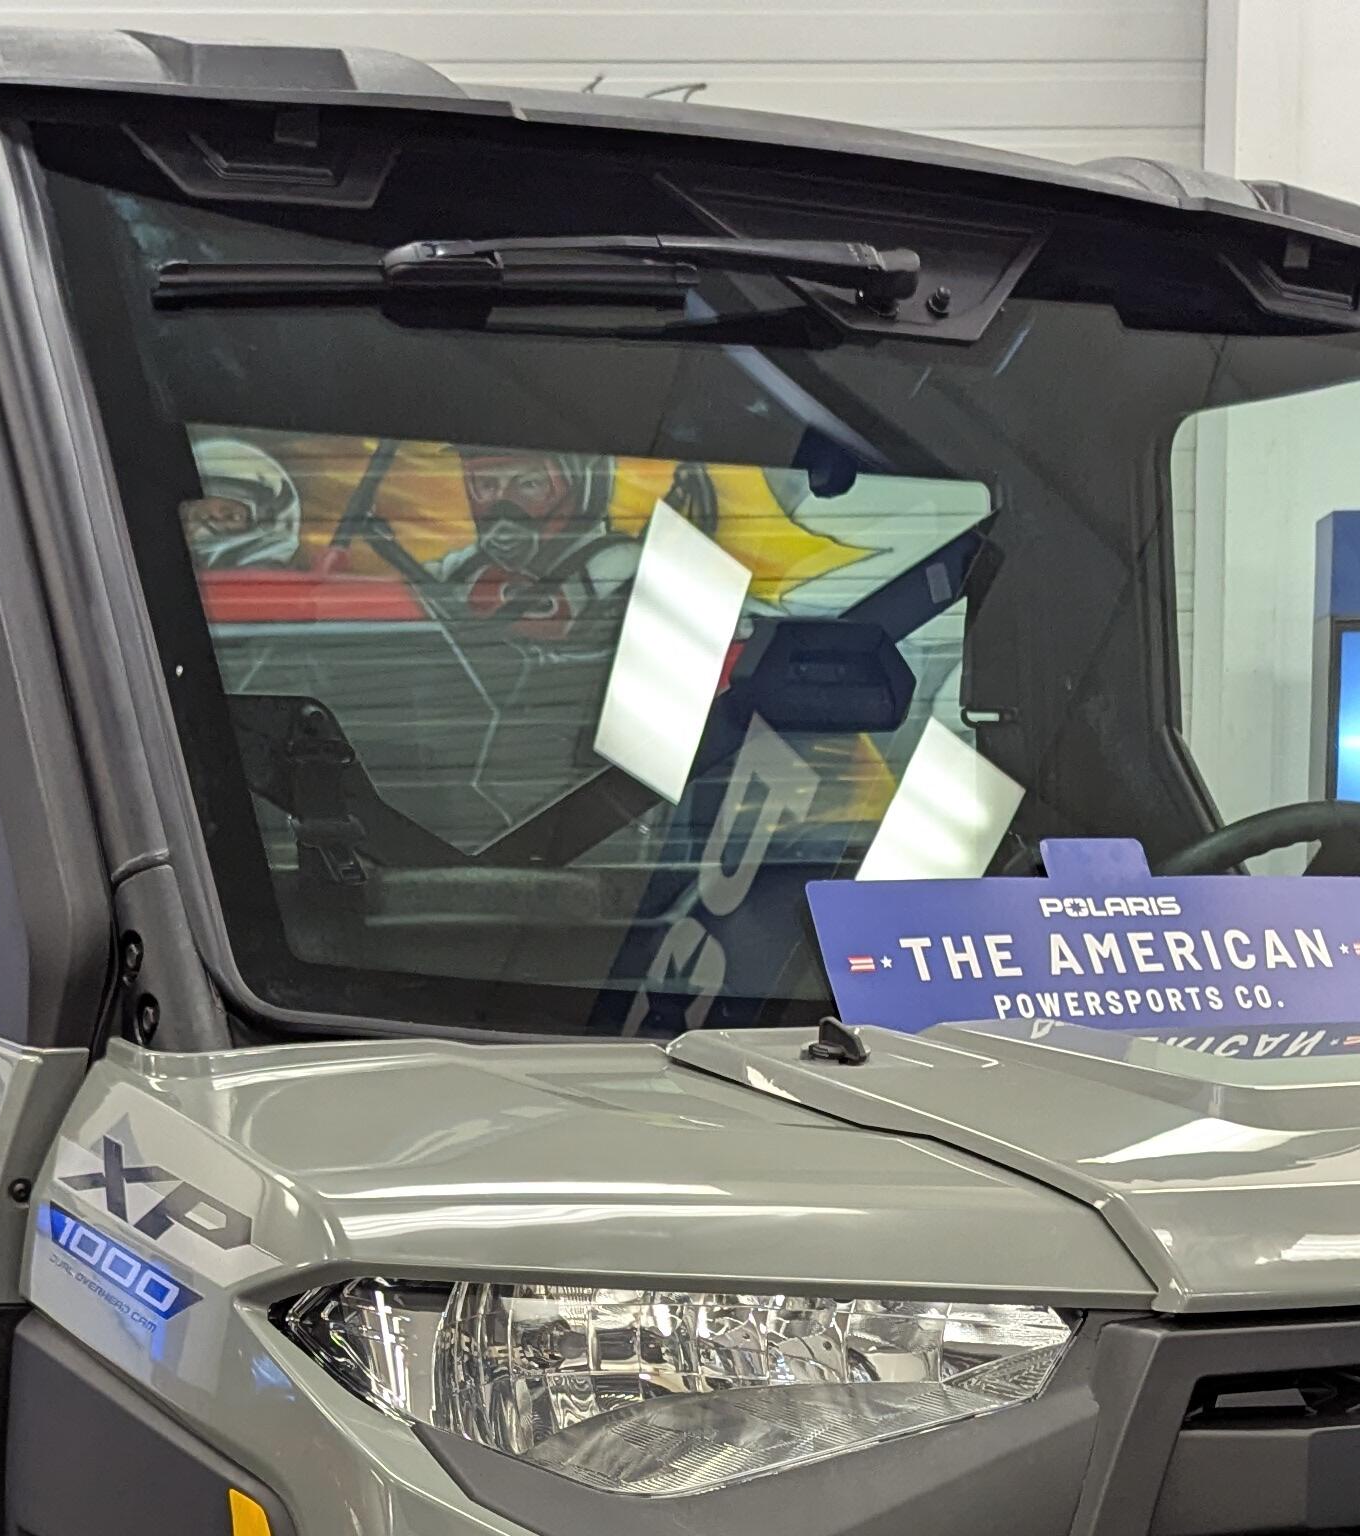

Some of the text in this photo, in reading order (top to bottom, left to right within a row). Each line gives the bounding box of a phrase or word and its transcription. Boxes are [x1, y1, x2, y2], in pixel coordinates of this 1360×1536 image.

[1039, 896, 1181, 919] POLARIS
[899, 928, 1334, 982] THE AMERICAN
[993, 984, 1285, 1020] POWERSPORTS CO.
[57, 1134, 253, 1250] XP
[49, 1254, 157, 1334] DUAL OVERHEAD CAM
[58, 1216, 180, 1312] 1000
